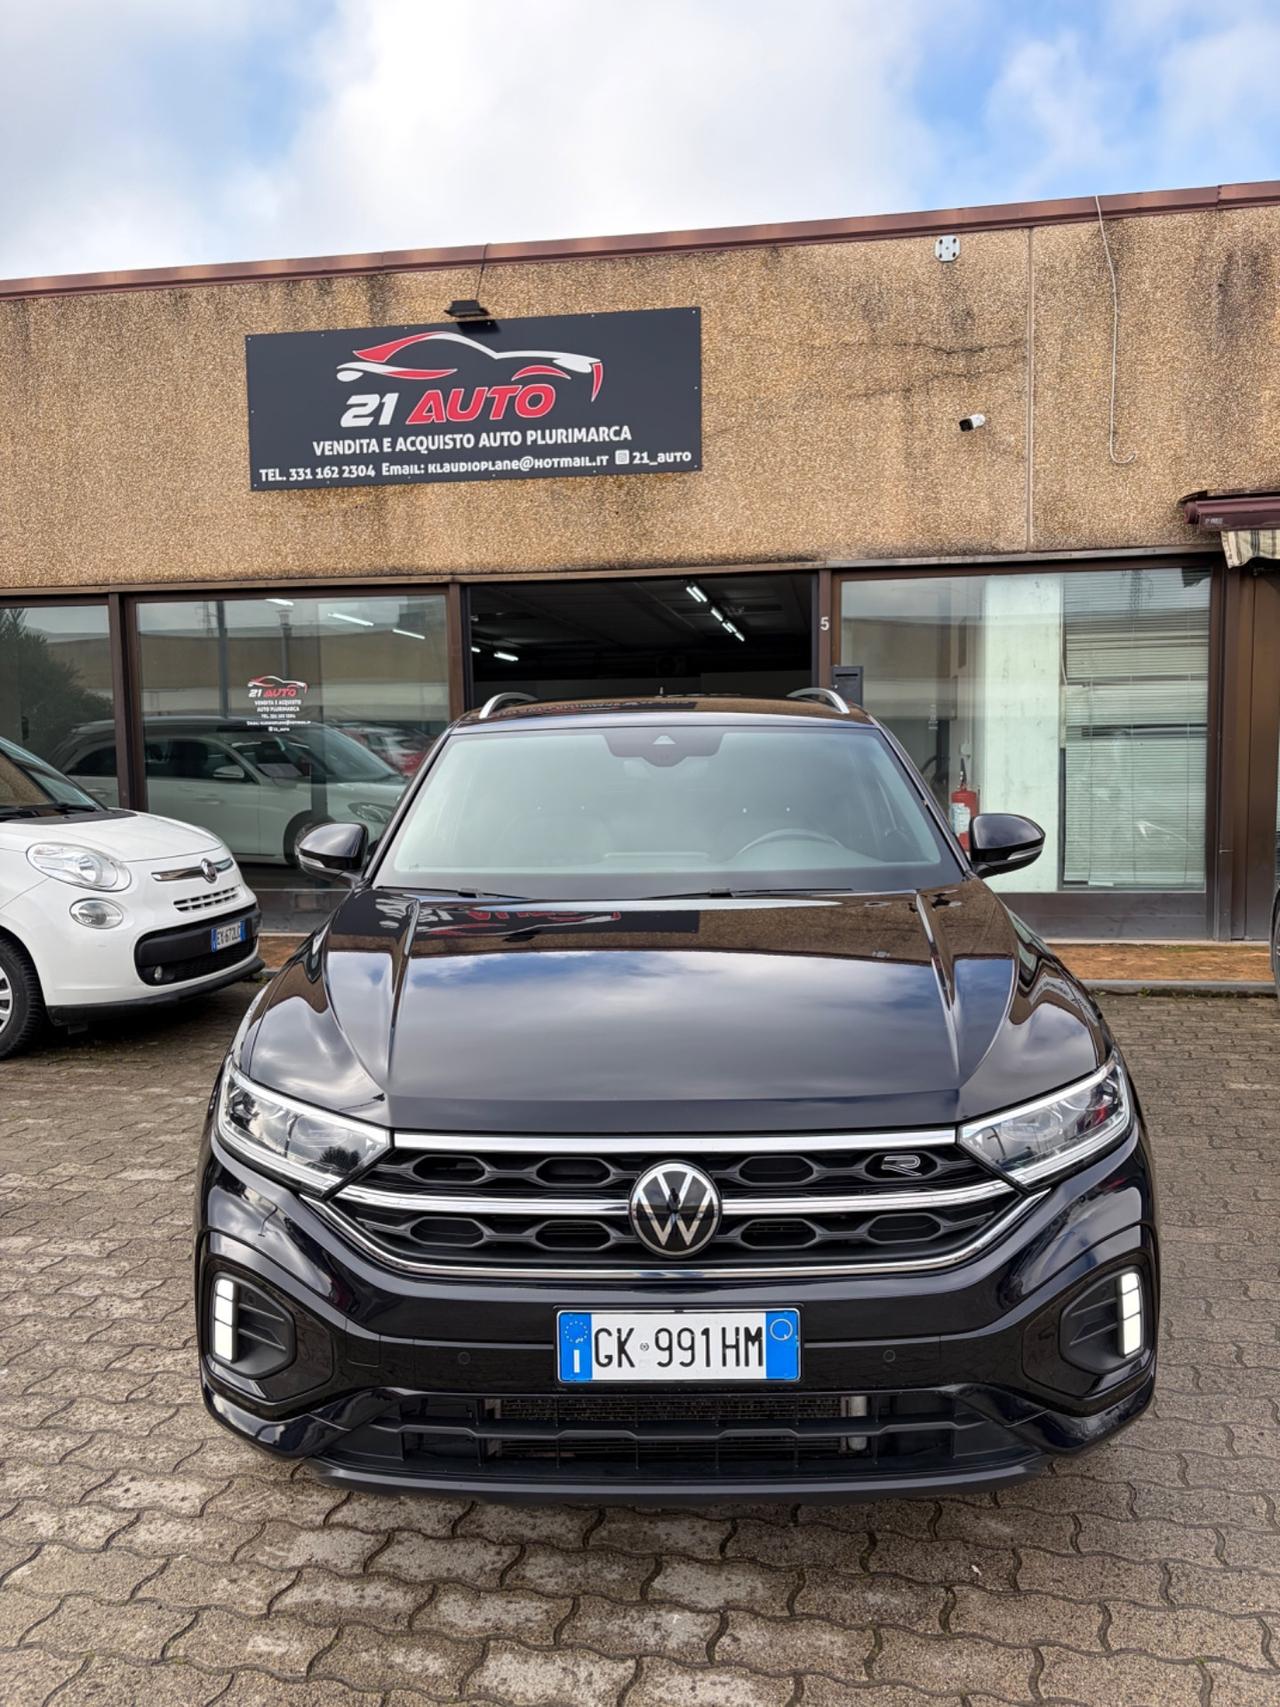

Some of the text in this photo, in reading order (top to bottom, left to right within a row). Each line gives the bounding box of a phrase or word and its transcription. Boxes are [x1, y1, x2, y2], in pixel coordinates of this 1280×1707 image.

[340, 383, 556, 428] 21 AUTO
[312, 424, 632, 457] VENDITA E ACQUISTO AUTO PLURIMARCA
[258, 468, 287, 482] TEL.
[288, 467, 313, 481] 331
[315, 465, 340, 480] 162
[341, 464, 377, 479] 2304
[820, 616, 830, 631] 5
[248, 688, 296, 698] 21 AUTO
[573, 1326, 764, 1373] I GK 991HM
